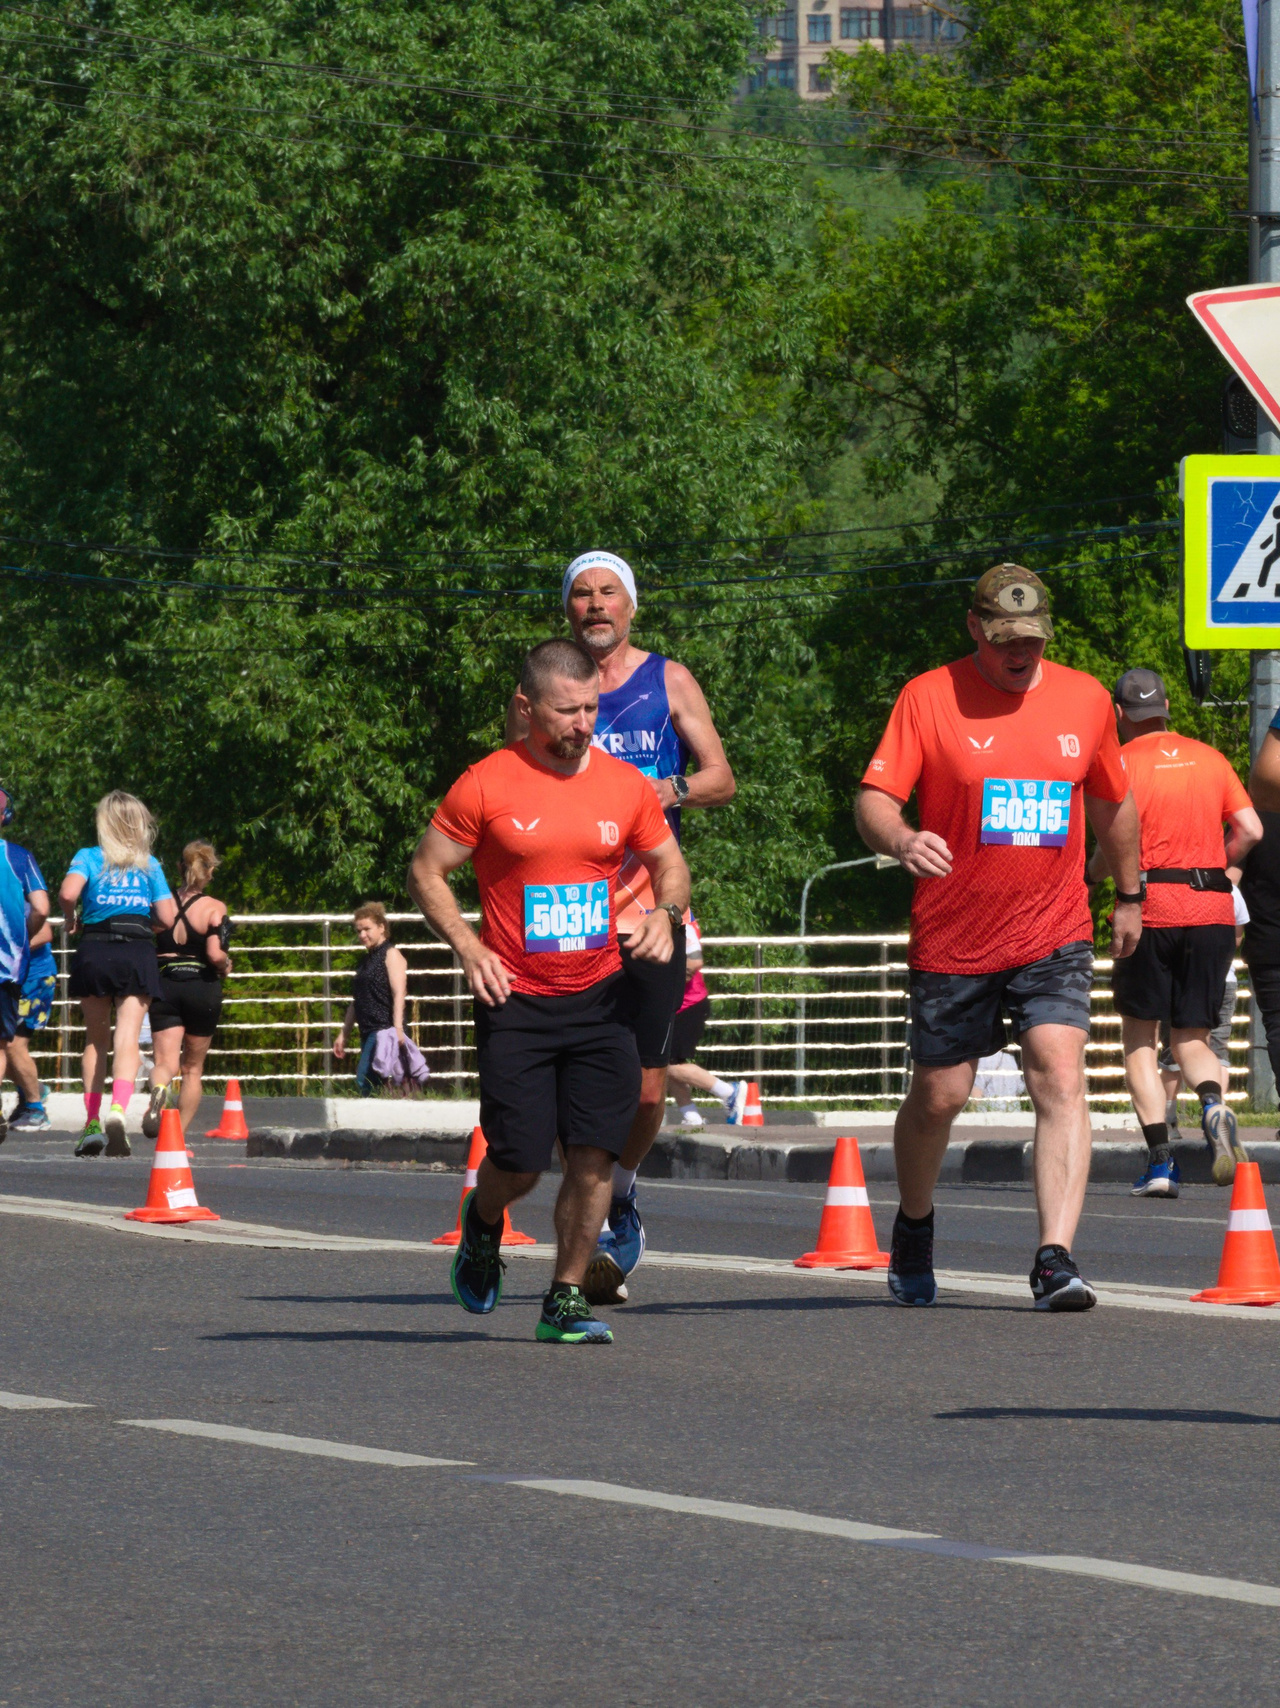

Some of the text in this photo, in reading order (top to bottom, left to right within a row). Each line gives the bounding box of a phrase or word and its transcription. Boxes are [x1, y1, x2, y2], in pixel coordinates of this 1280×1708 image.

[990, 796, 1062, 832] 50315
[1011, 831, 1040, 847] 10KM
[533, 899, 604, 938] 50314
[558, 935, 587, 953] 10KM
